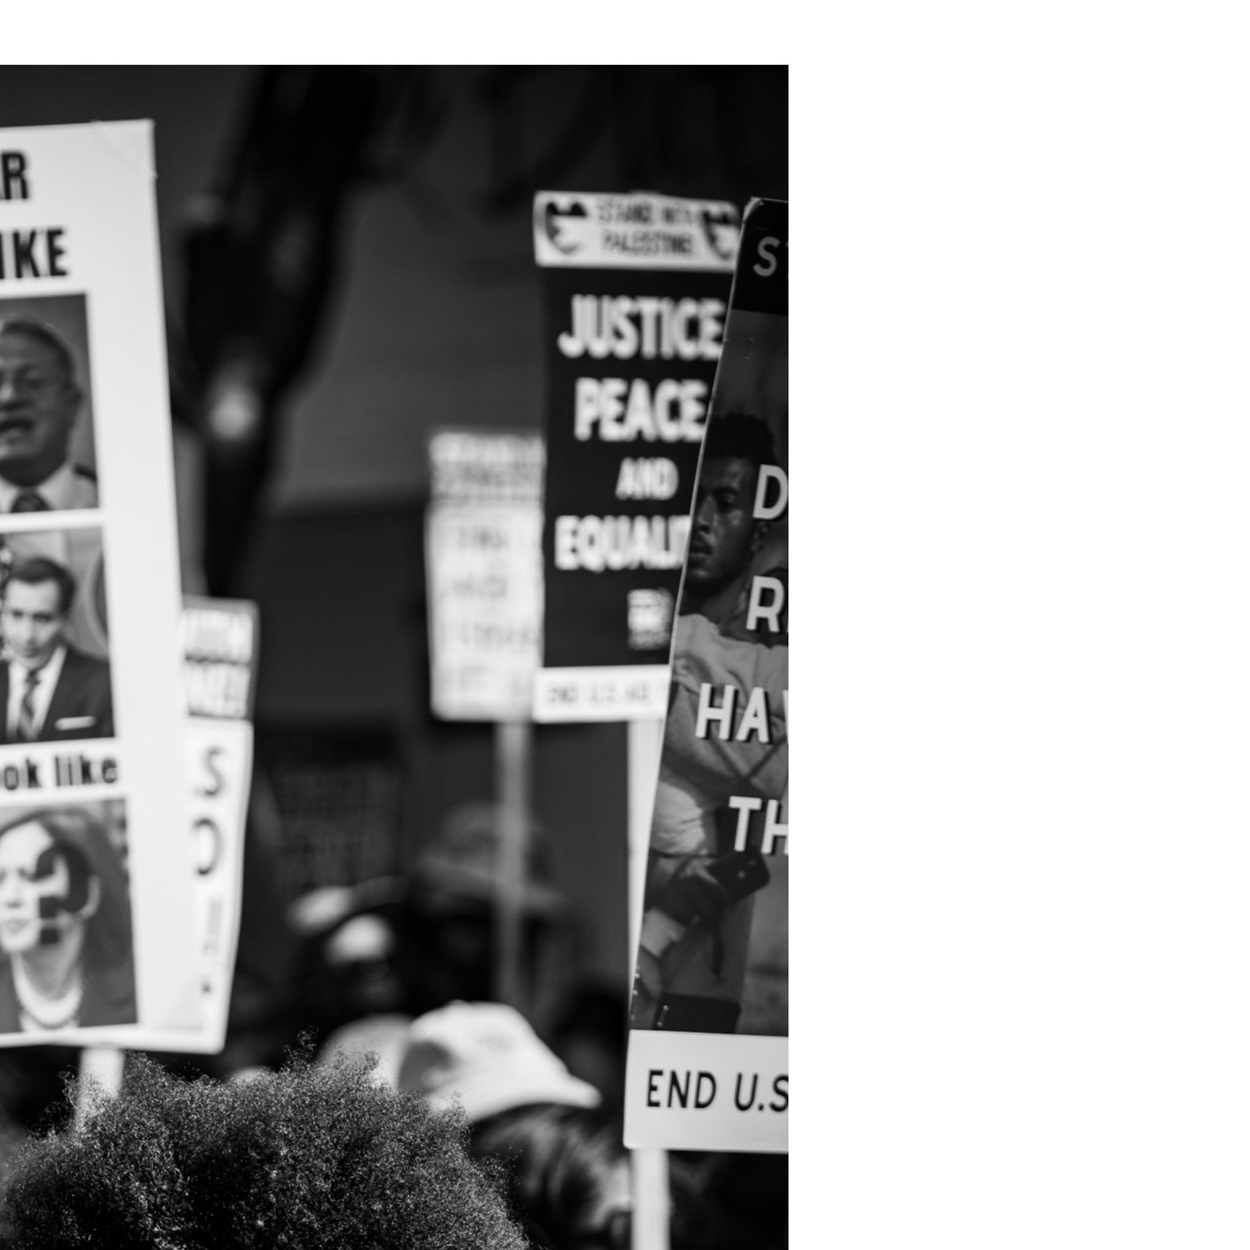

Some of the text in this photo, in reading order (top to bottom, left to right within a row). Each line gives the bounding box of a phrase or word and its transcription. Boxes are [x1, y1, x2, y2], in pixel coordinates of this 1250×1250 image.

[602, 230, 696, 255] PALESTINE
[753, 236, 788, 277] S
[558, 294, 726, 361] JUSTICE
[575, 377, 707, 442] PEACE
[615, 457, 679, 500] AND
[695, 682, 788, 743] HA
[54, 754, 119, 788] like
[646, 1069, 717, 1109] END
